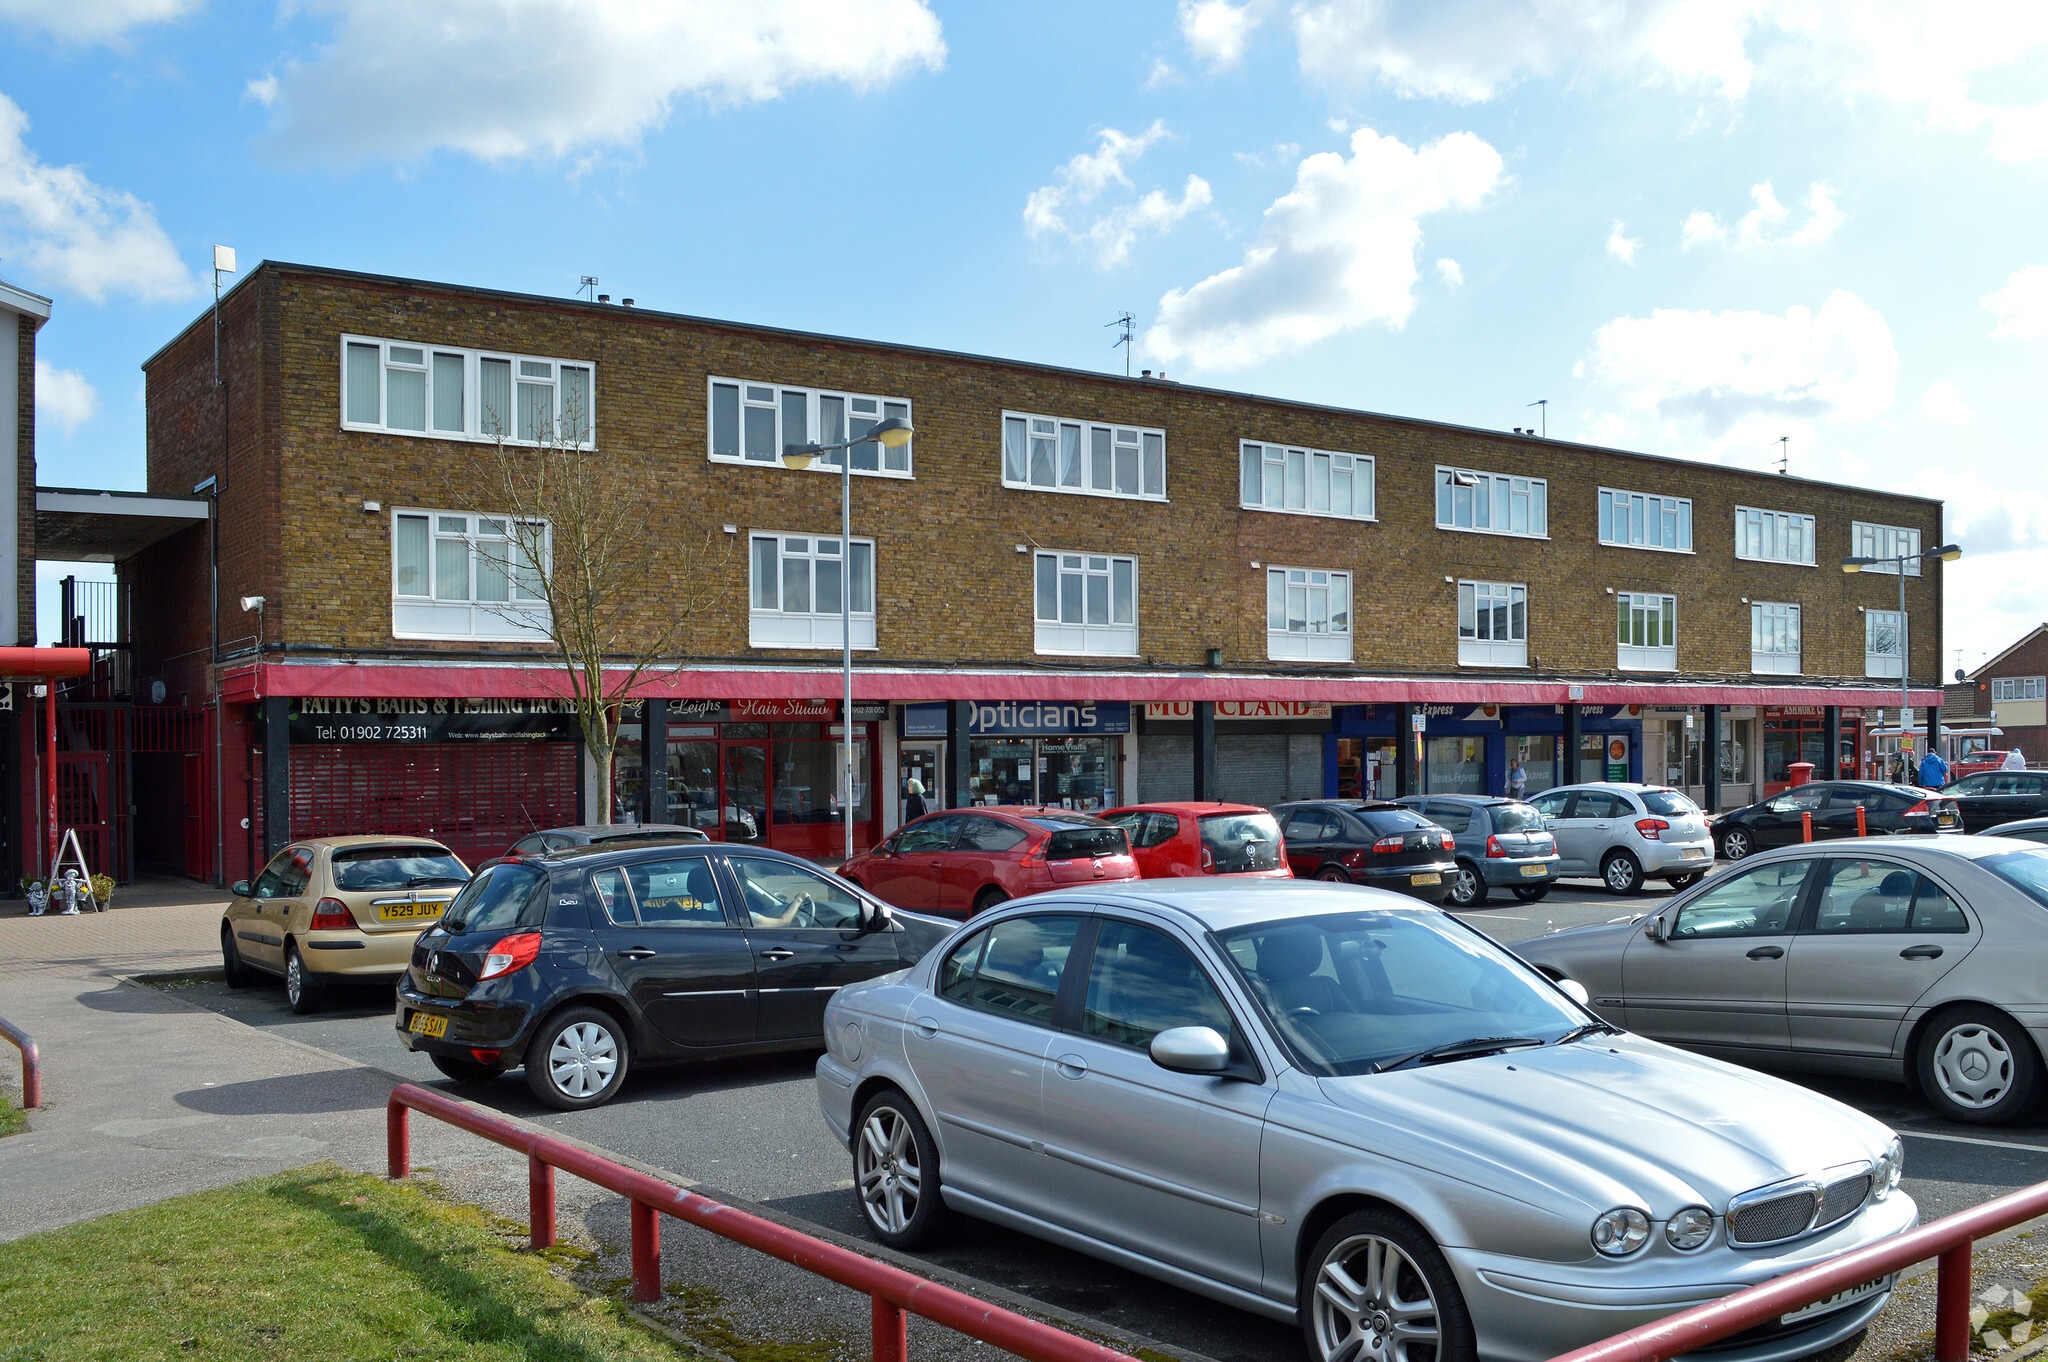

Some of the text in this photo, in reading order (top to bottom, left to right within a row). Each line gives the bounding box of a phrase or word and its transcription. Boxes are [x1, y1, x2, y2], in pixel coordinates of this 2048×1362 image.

[301, 698, 371, 714] FATTY'S
[376, 698, 428, 714] BAITS
[433, 698, 449, 714] &
[737, 699, 780, 716] Hair
[1422, 703, 1455, 718] Express
[316, 726, 427, 739] Tel: 01902 725311
[1450, 771, 1480, 785] Express
[384, 903, 438, 917] Y529 JUY
